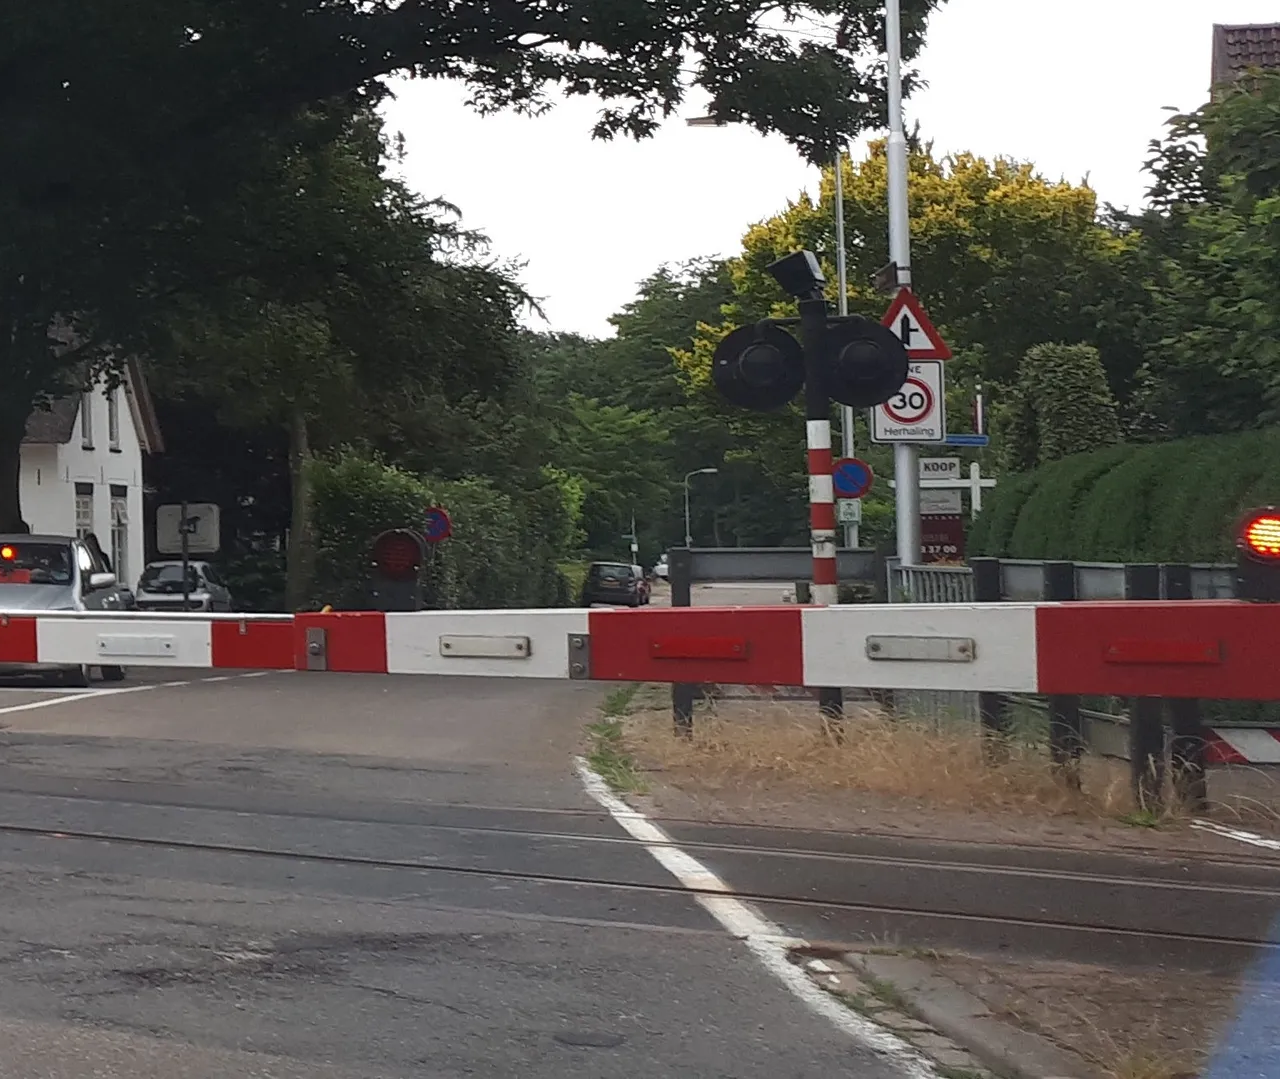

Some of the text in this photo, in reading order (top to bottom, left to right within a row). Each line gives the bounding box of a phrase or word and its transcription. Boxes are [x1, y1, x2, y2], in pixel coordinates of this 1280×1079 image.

[892, 392, 925, 410] 30
[884, 427, 935, 437] Herhaling
[924, 462, 956, 472] KOOP
